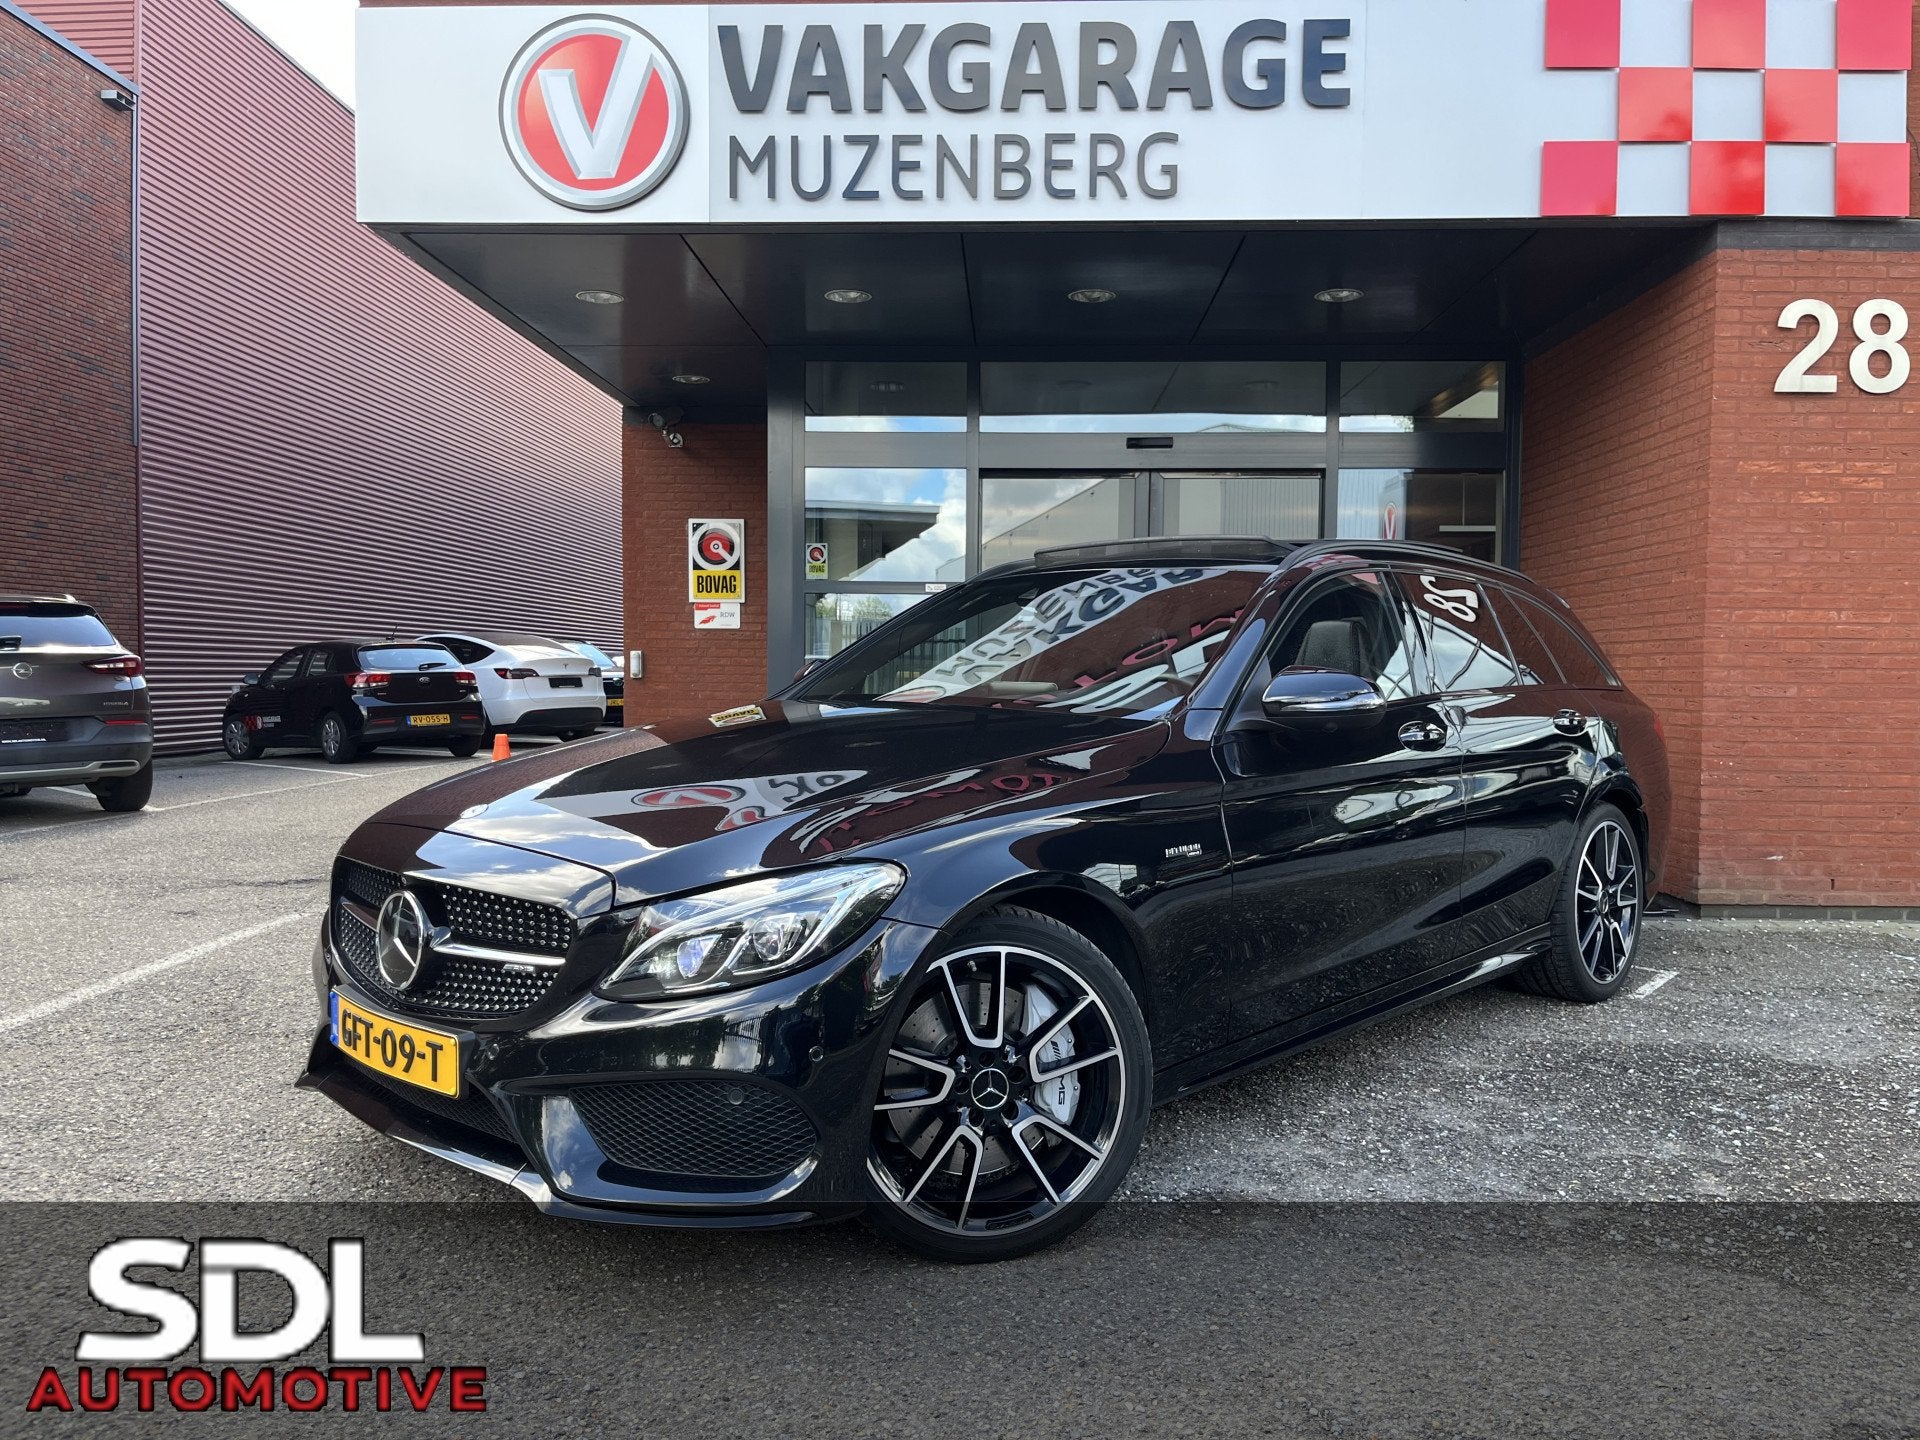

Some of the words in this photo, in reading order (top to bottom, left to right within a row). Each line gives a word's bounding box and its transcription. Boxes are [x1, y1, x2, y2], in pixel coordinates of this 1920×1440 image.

[718, 19, 1351, 113] VAKGARAGE
[730, 132, 1181, 201] MUZENBERG
[1774, 299, 1911, 394] 28
[696, 575, 737, 594] BOVAG
[808, 563, 826, 574] BOVAG
[342, 1008, 443, 1083] GFT-09-T
